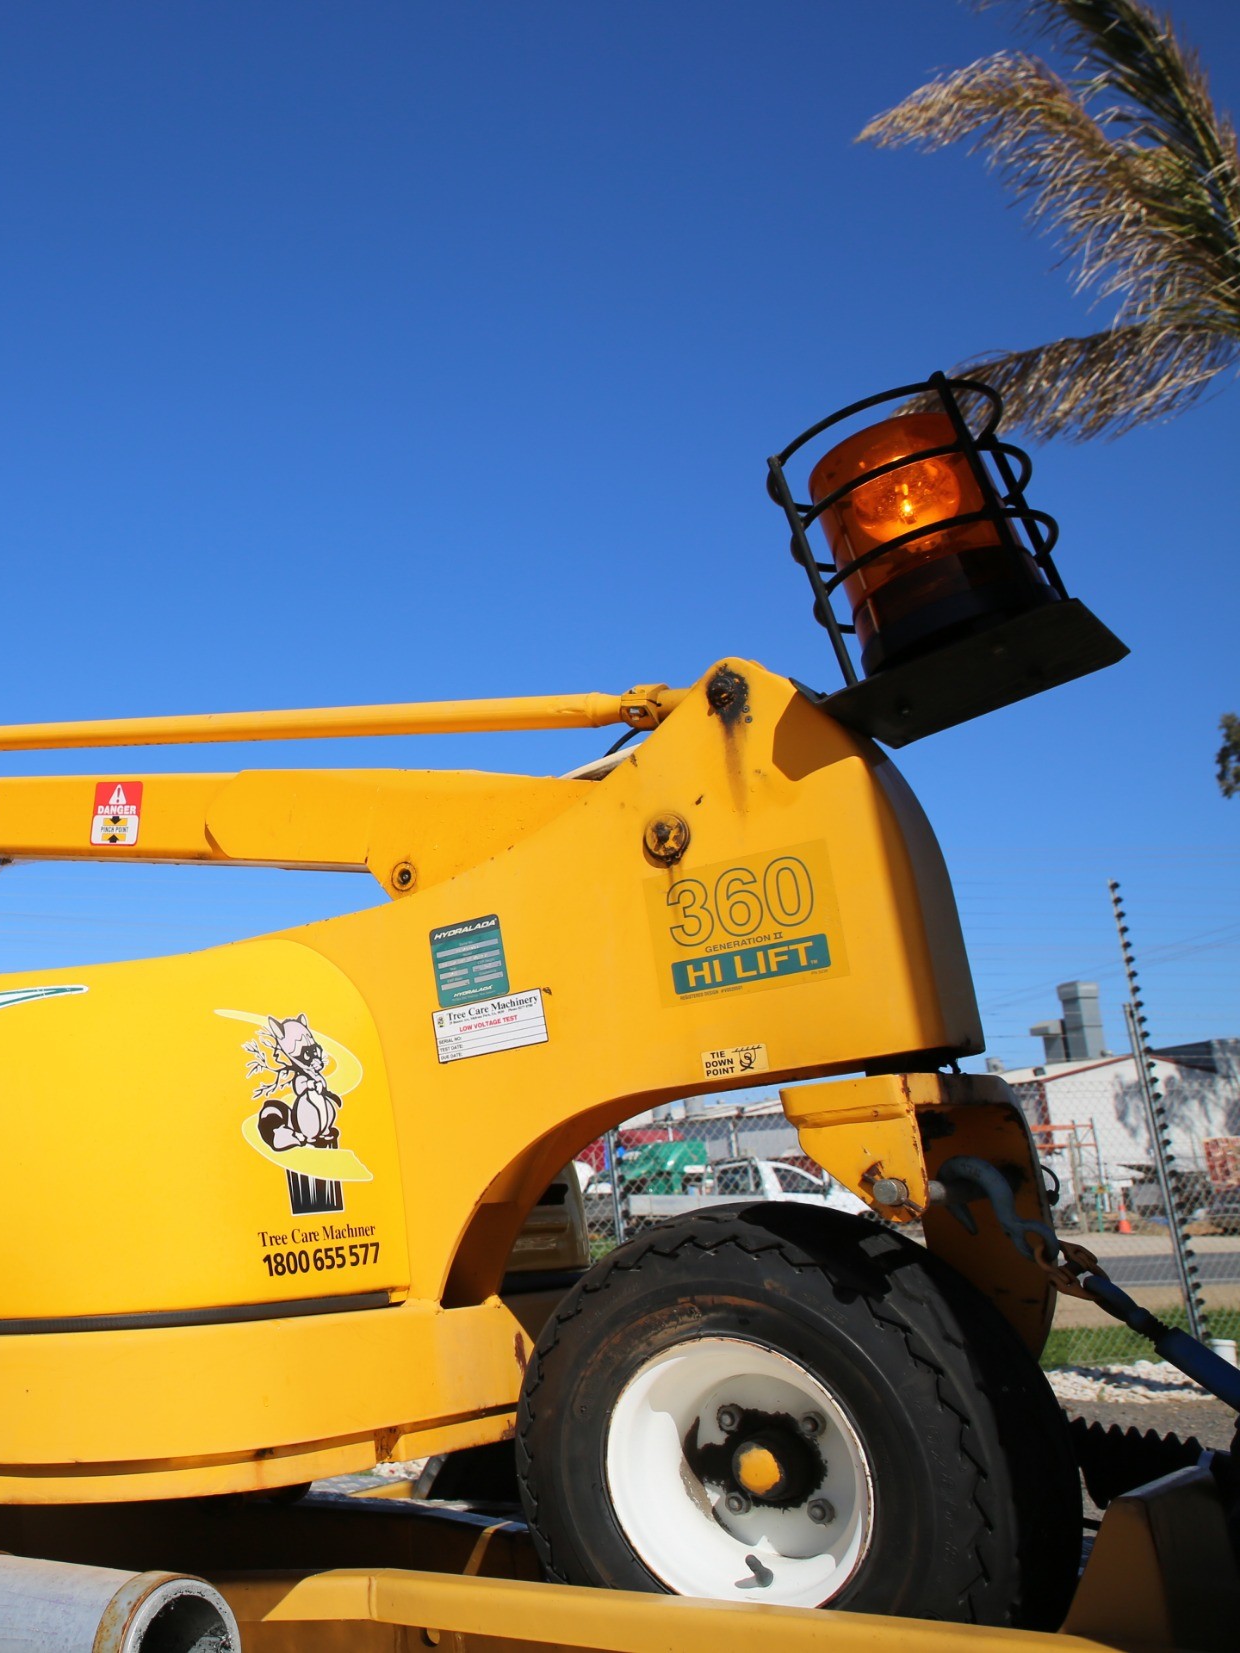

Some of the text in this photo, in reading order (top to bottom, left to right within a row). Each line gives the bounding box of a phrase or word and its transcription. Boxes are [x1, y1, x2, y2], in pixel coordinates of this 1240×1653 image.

[97, 805, 137, 815] DANGER
[667, 856, 814, 947] 360
[705, 934, 771, 953] GENERATION
[686, 959, 723, 987] HI
[734, 941, 813, 978] LIFT
[448, 1012, 466, 1021] Tree
[468, 1007, 490, 1016] Care
[491, 995, 538, 1011] Machinery
[459, 1024, 473, 1032] LOW
[474, 1018, 502, 1029] VOLTAGE
[705, 1058, 734, 1068] DOWN
[710, 1051, 726, 1059] TIE
[706, 1067, 735, 1077] POINT
[258, 1231, 287, 1247] Tree
[291, 1229, 320, 1243] Care
[262, 1242, 380, 1276] 1800 655 577
